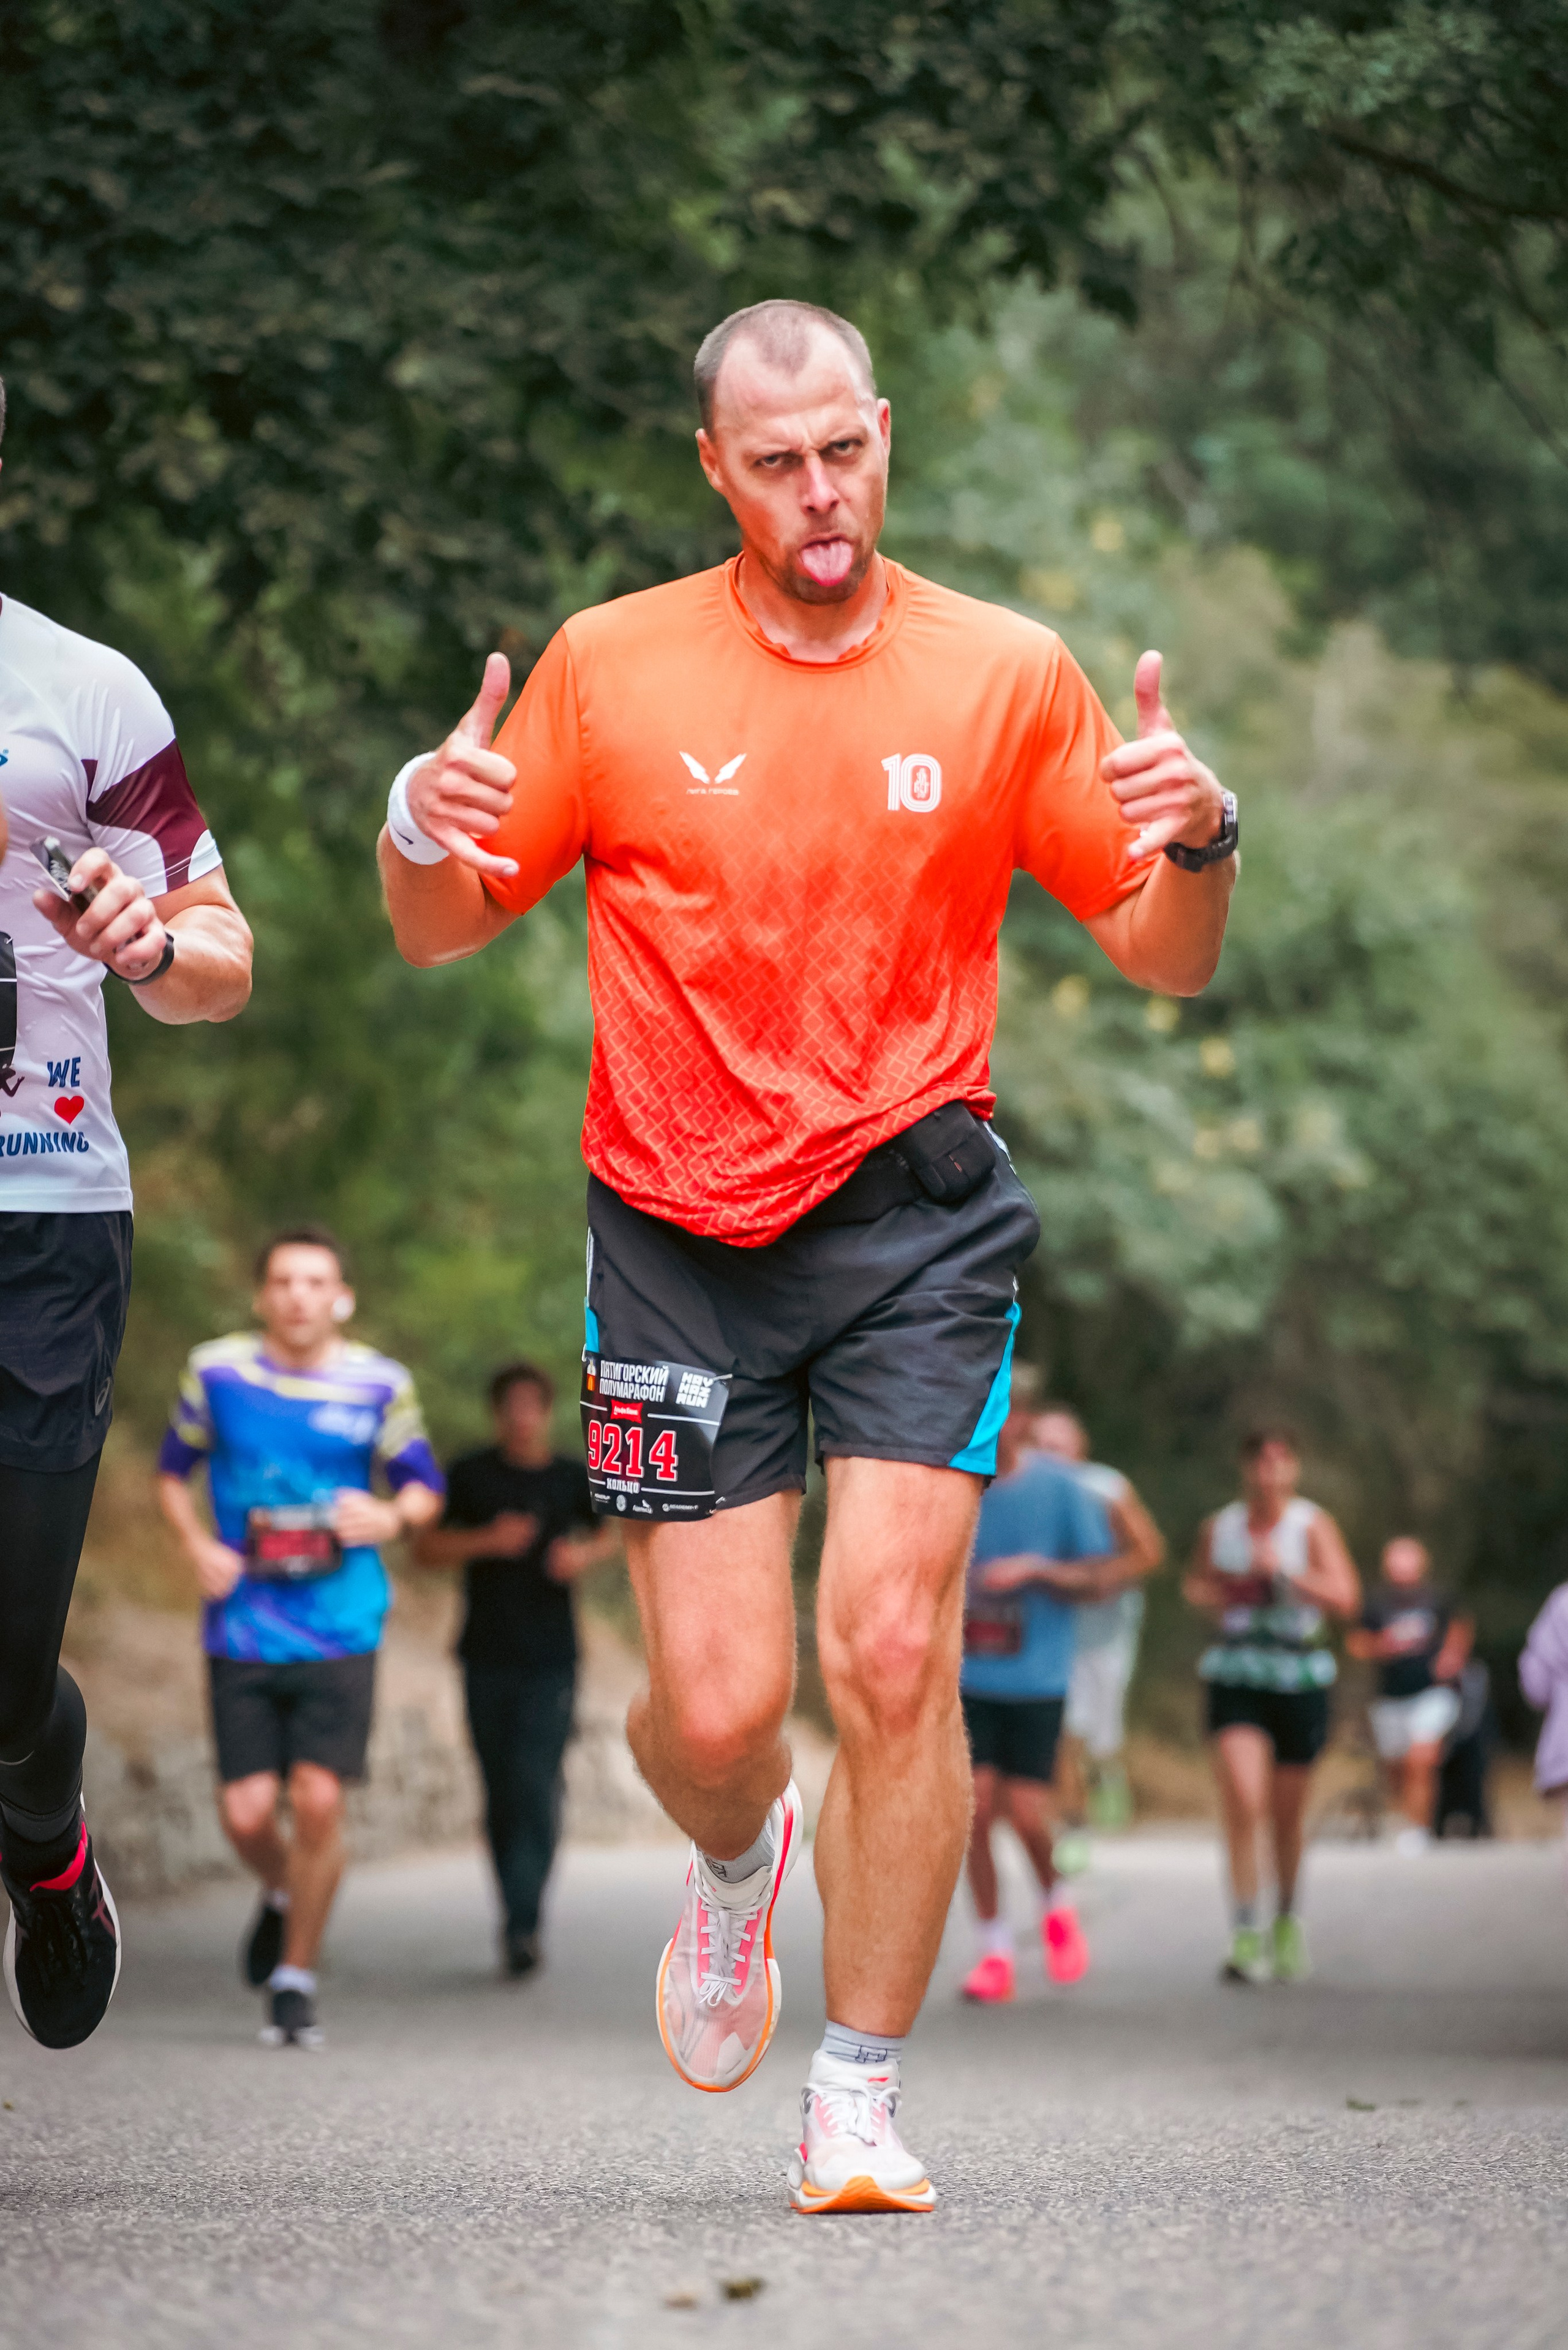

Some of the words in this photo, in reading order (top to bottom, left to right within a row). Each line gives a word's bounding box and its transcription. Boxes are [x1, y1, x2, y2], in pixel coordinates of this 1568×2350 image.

[881, 753, 942, 813] 10
[47, 1056, 81, 1087] WE
[600, 1360, 669, 1386] ПЯТИГОРСКИЙ
[599, 1377, 666, 1403] ПОЛУМАРАФОН
[588, 1420, 679, 1482] 9214
[606, 1477, 641, 1494] КОЛЬЦО
